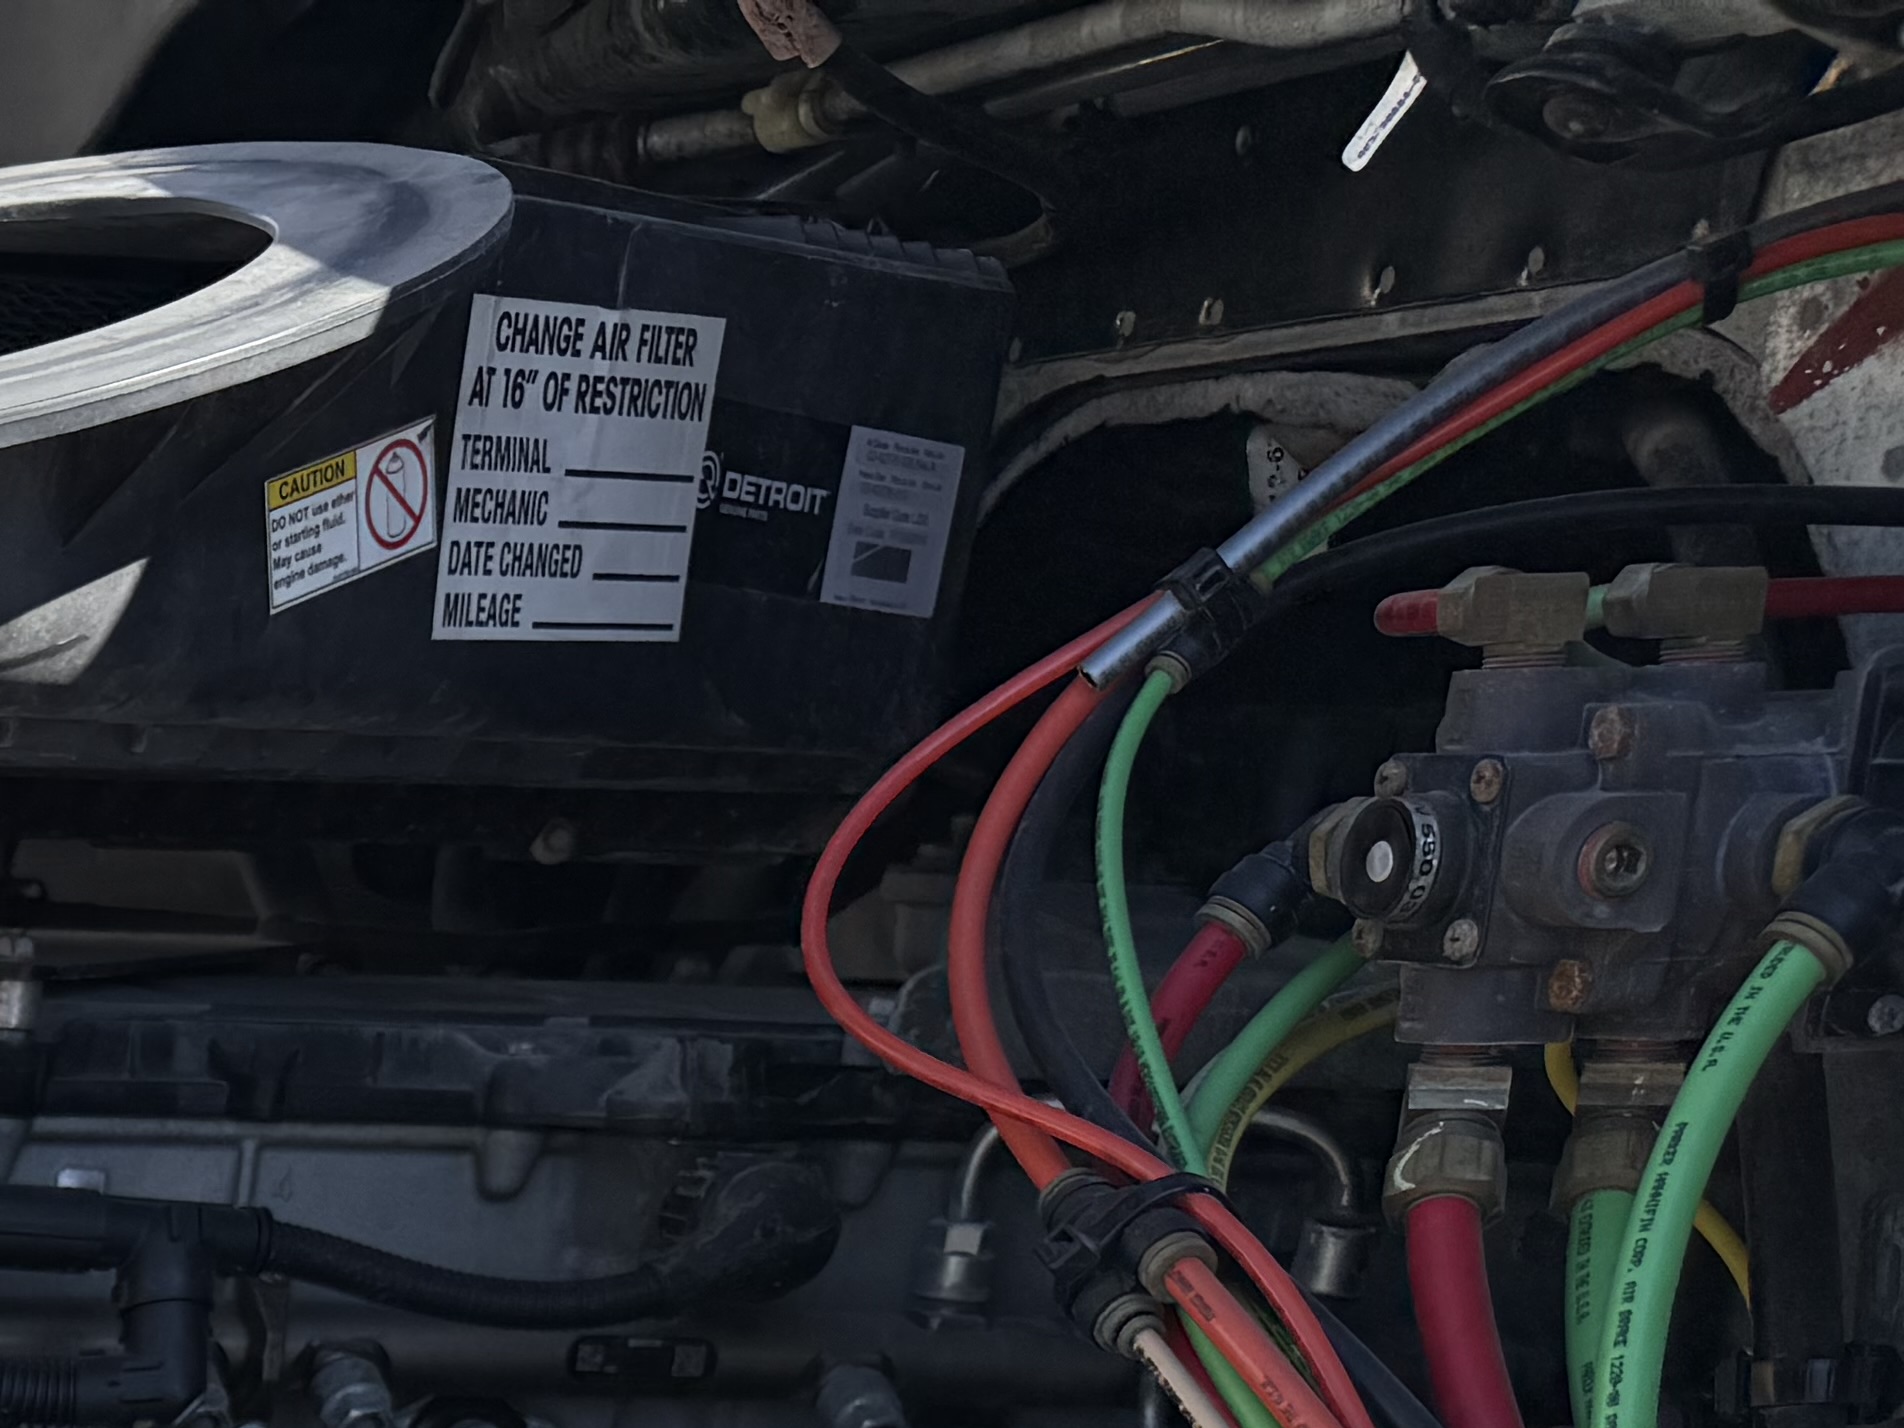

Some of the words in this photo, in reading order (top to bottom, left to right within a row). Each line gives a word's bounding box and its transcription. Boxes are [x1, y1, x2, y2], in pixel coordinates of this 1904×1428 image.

[496, 311, 585, 358] CHANGE
[590, 321, 631, 362] AIR
[636, 323, 698, 367] FILTER
[468, 366, 496, 407] AT
[502, 367, 539, 409] 16"
[542, 370, 571, 412] OF
[574, 374, 707, 422] RESTRICTION
[460, 433, 551, 474] TERMINAL
[279, 460, 345, 499] CAUTION
[722, 470, 831, 515] DETROIT
[271, 516, 286, 533] DO
[289, 506, 309, 526] NOT
[312, 501, 329, 517] use
[453, 487, 549, 526] MECHANIC
[272, 537, 282, 551] or
[285, 524, 321, 547] starting
[273, 555, 291, 571] May
[294, 543, 322, 563] cause
[273, 568, 305, 590] engine
[447, 540, 494, 577] DATE
[499, 541, 583, 579] CHANGED
[442, 592, 522, 628] MILEAGE
